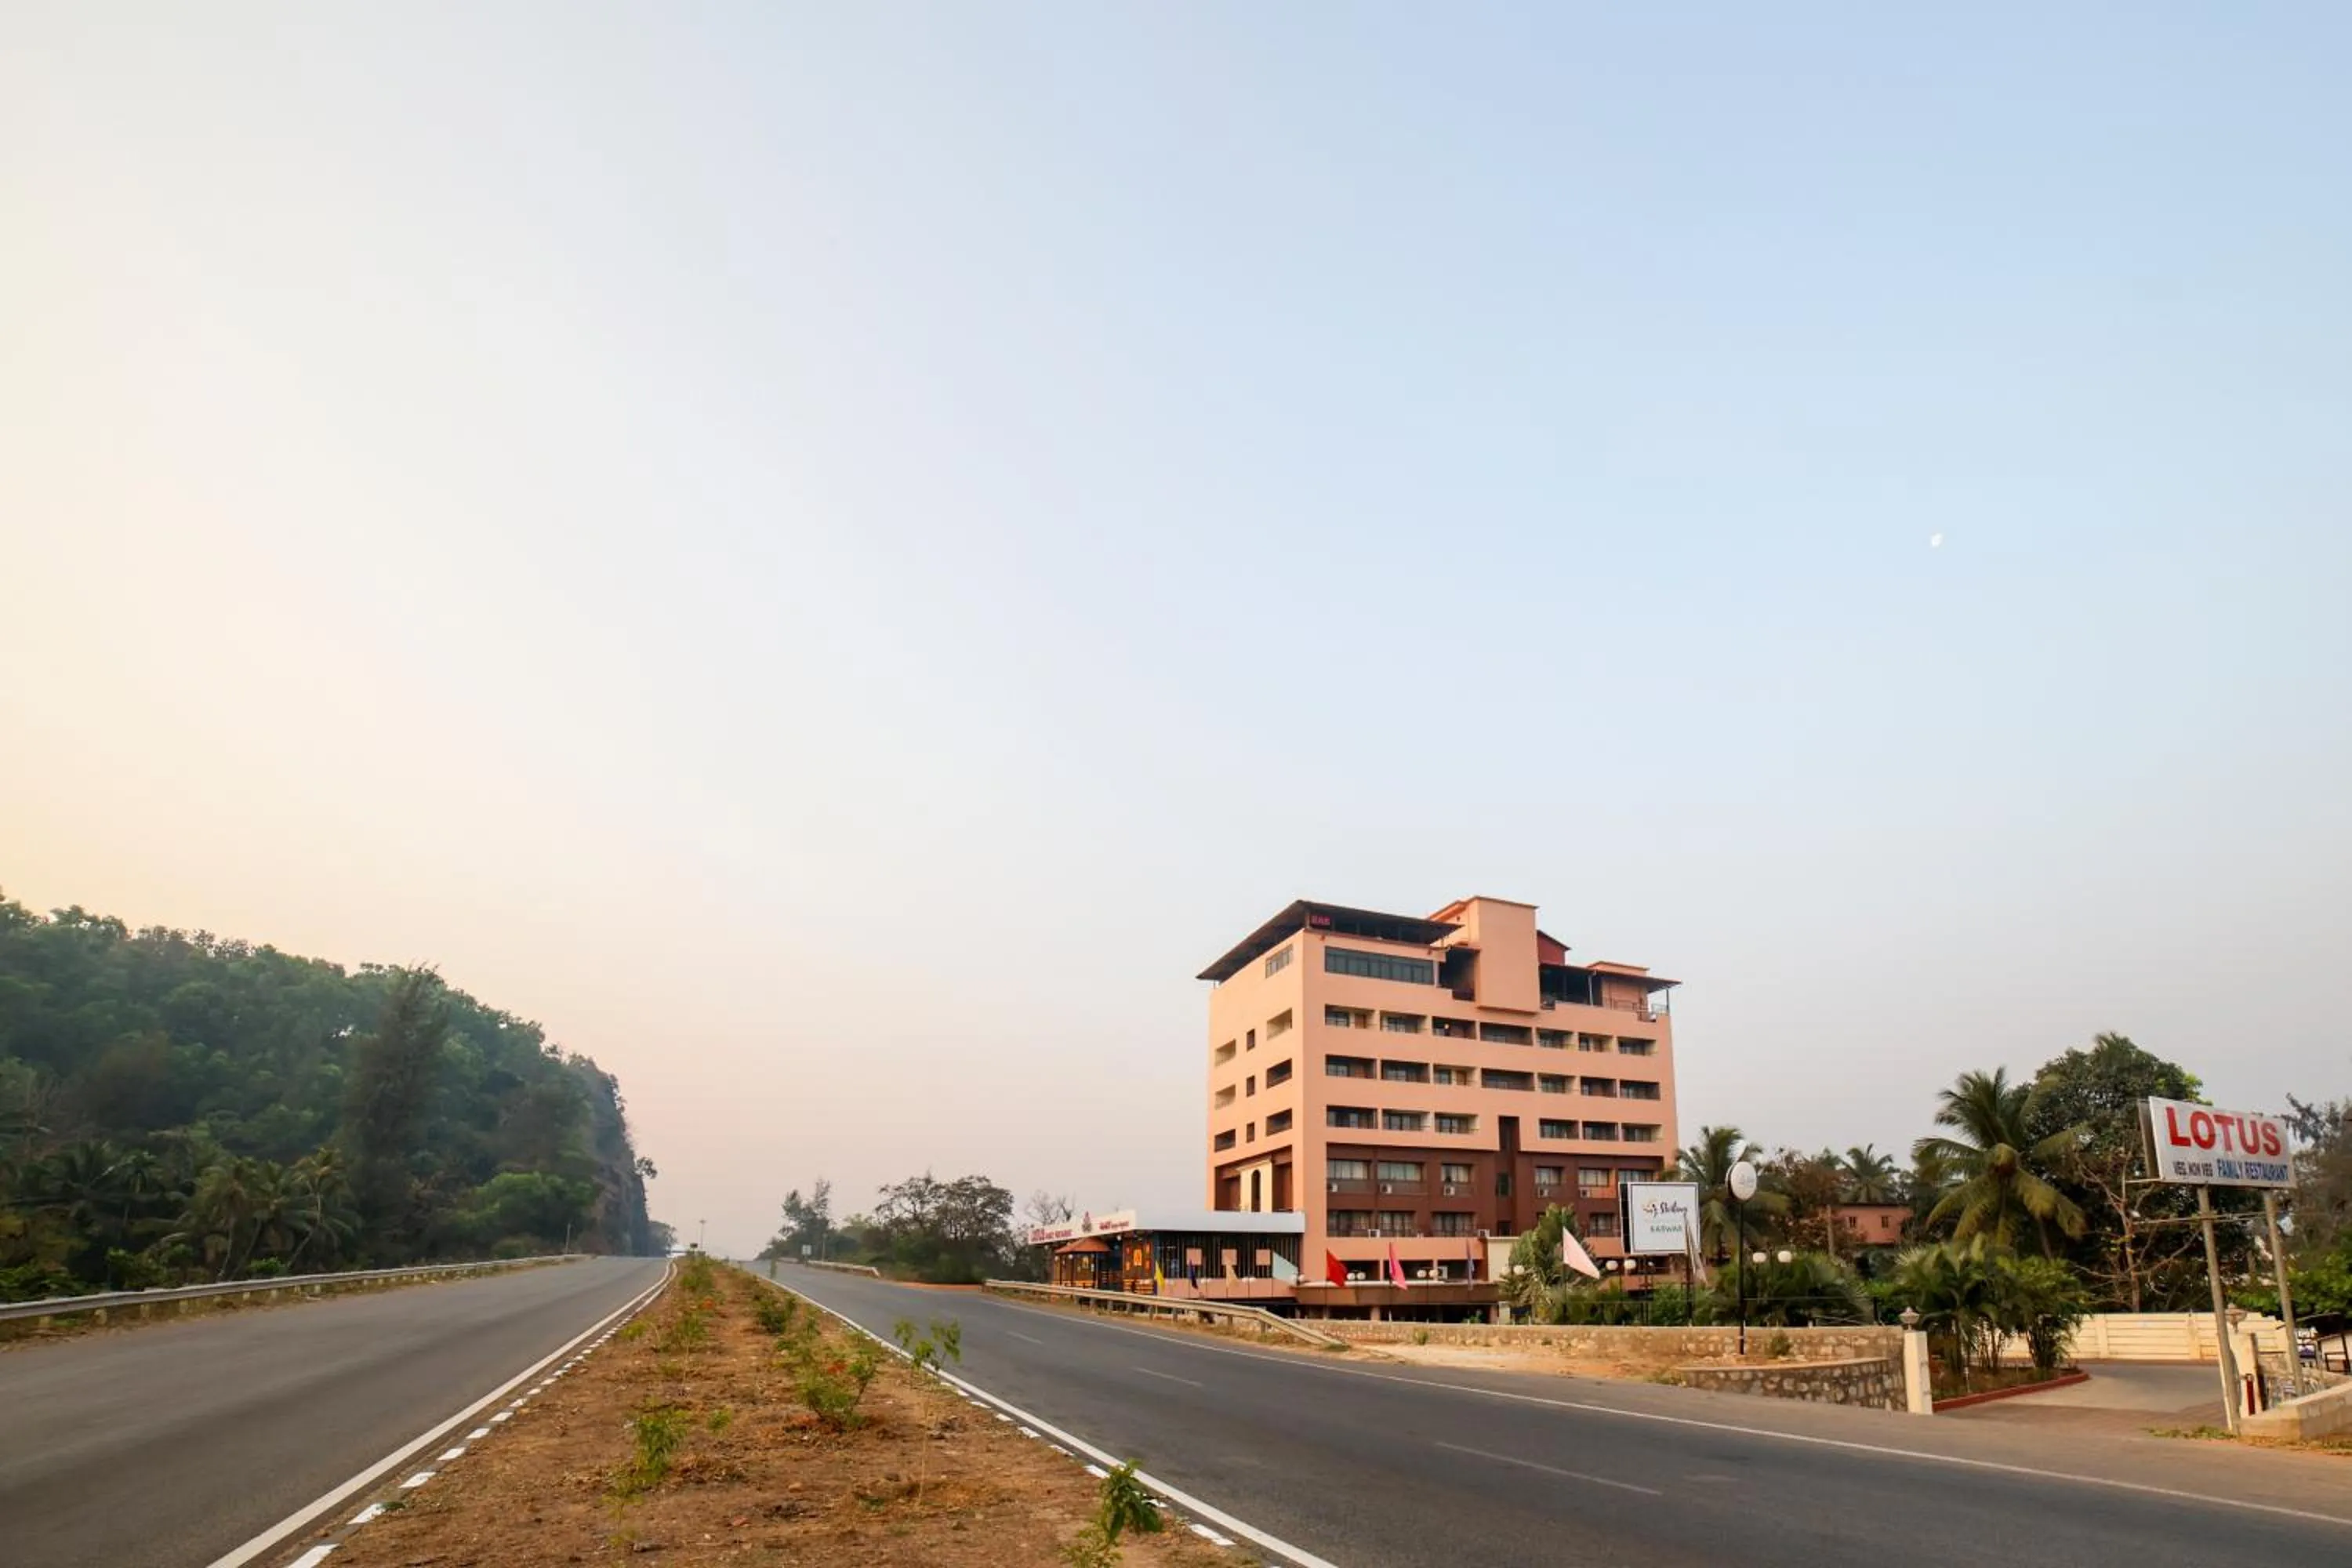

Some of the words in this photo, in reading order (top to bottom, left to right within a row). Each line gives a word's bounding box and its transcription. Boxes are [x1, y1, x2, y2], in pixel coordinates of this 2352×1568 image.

[2165, 1105, 2281, 1156] LOTUS
[2217, 1158, 2242, 1179] FAMILY
[1650, 1225, 1682, 1233] KARWAR
